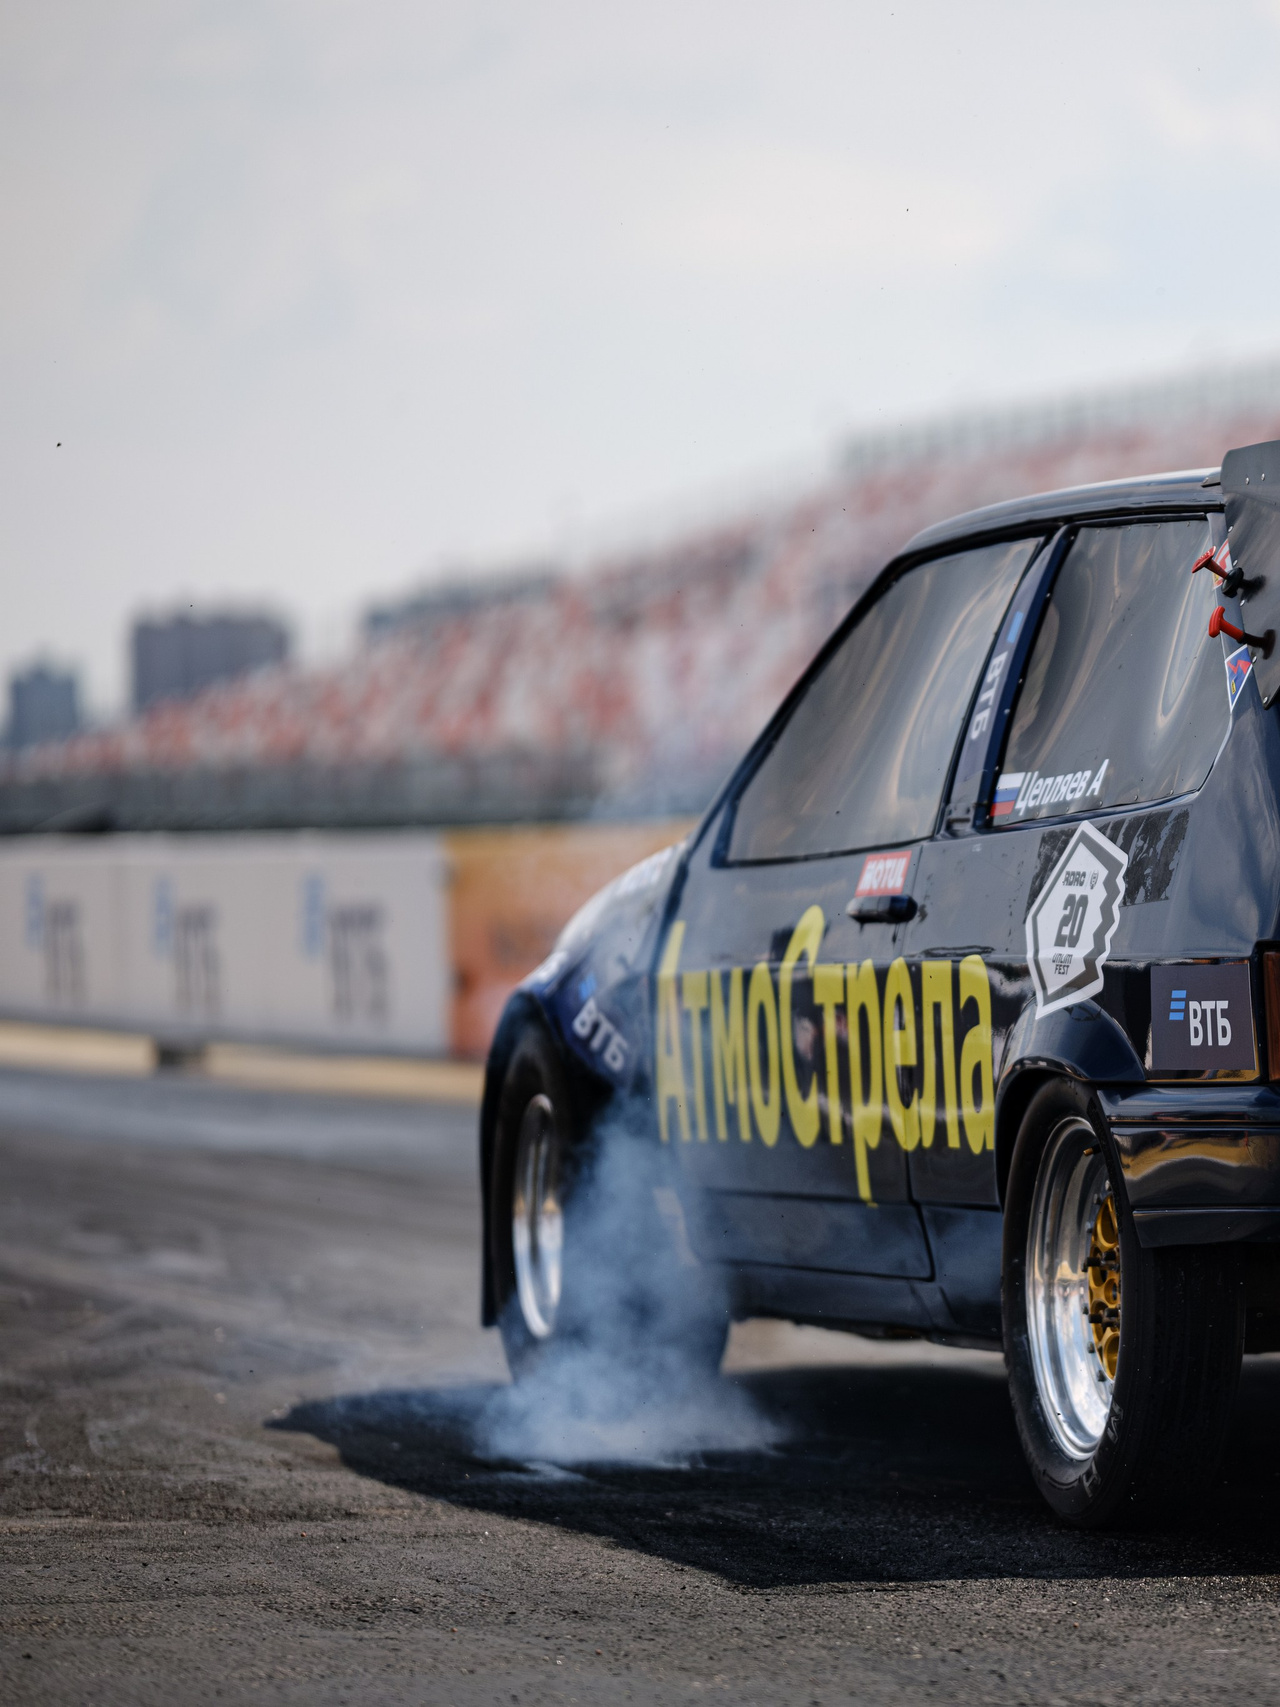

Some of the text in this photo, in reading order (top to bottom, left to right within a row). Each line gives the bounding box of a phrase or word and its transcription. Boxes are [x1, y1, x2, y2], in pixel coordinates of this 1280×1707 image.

[971, 650, 1009, 740] ВТБ
[1014, 770, 1092, 816] Цепляев
[858, 857, 907, 890] MOTUL
[1053, 893, 1089, 948] 20
[1054, 964, 1070, 976] FEST
[571, 996, 629, 1072] ВТБ
[1188, 1000, 1233, 1047] ВТБ
[656, 904, 996, 1208] АтмоСтрела
